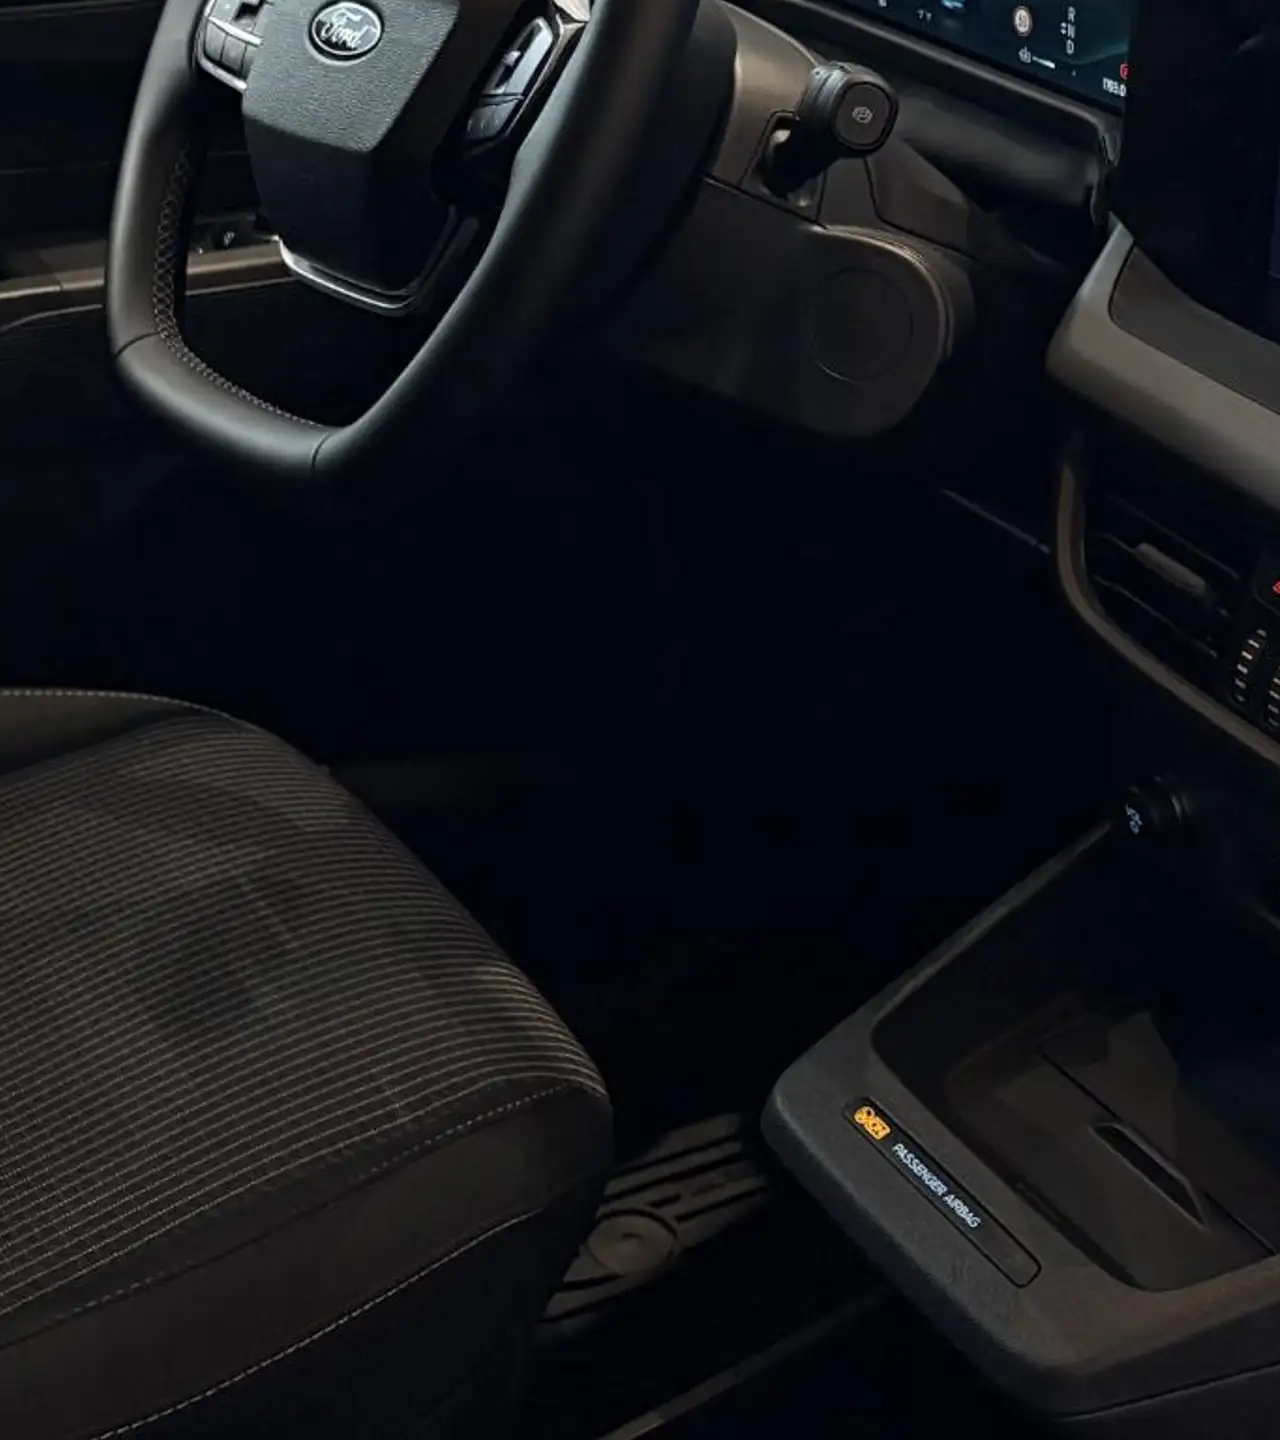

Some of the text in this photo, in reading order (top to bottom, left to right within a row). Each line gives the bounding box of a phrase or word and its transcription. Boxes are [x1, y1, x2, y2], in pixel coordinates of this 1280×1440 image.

[320, 7, 366, 50] Ford
[892, 1142, 981, 1228] PASSENGER AIRBAG
